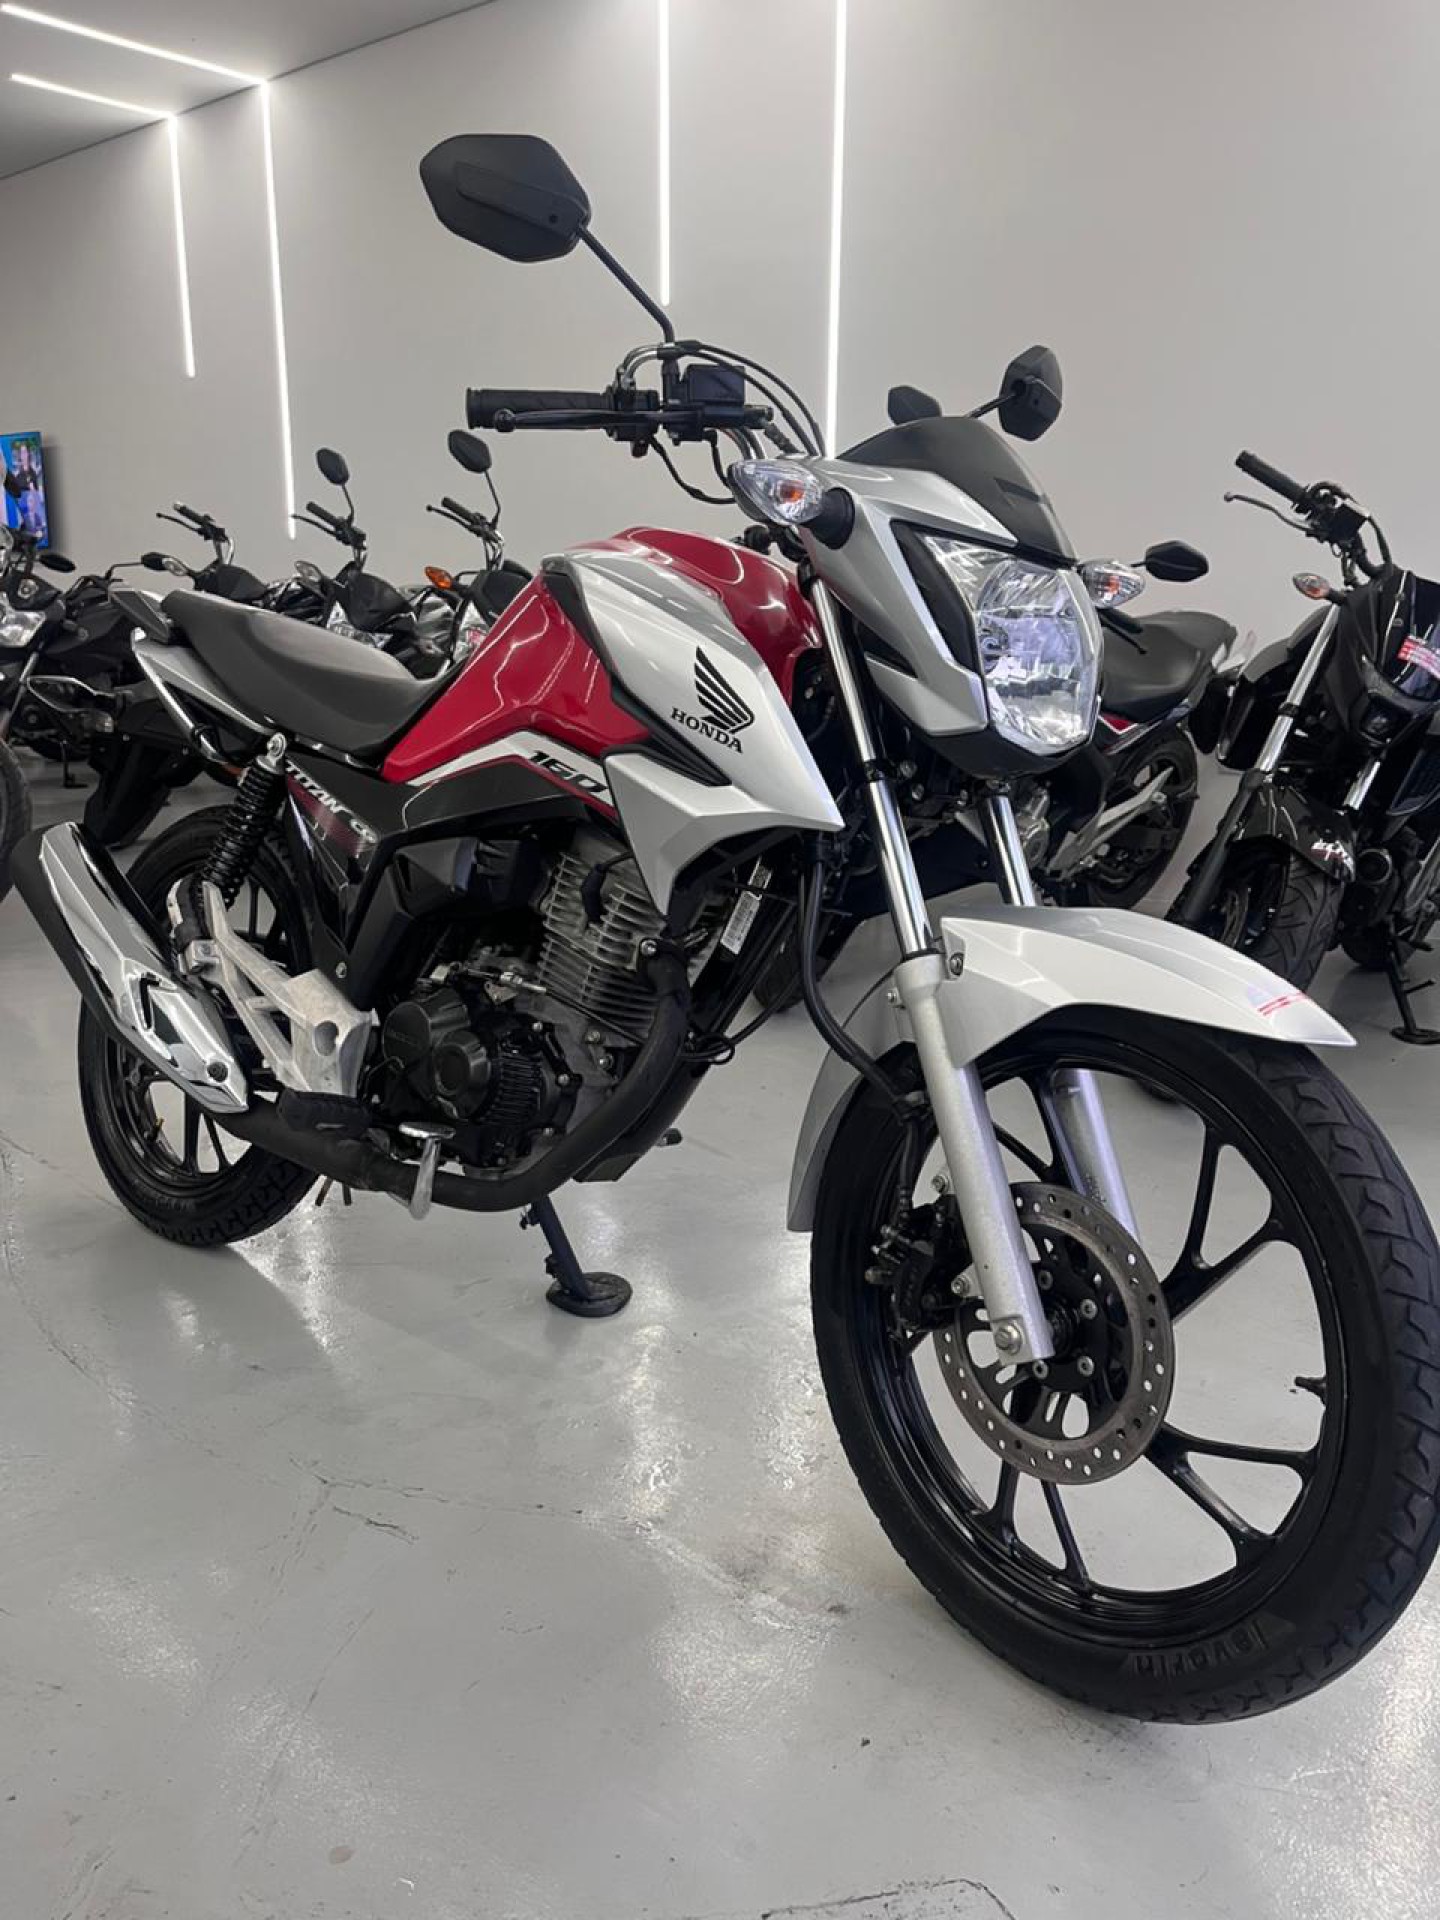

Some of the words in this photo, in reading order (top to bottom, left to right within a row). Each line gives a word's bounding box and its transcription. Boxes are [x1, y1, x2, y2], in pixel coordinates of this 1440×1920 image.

[671, 706, 743, 754] HONDA
[285, 759, 348, 814] TITAN
[529, 750, 608, 793] 160
